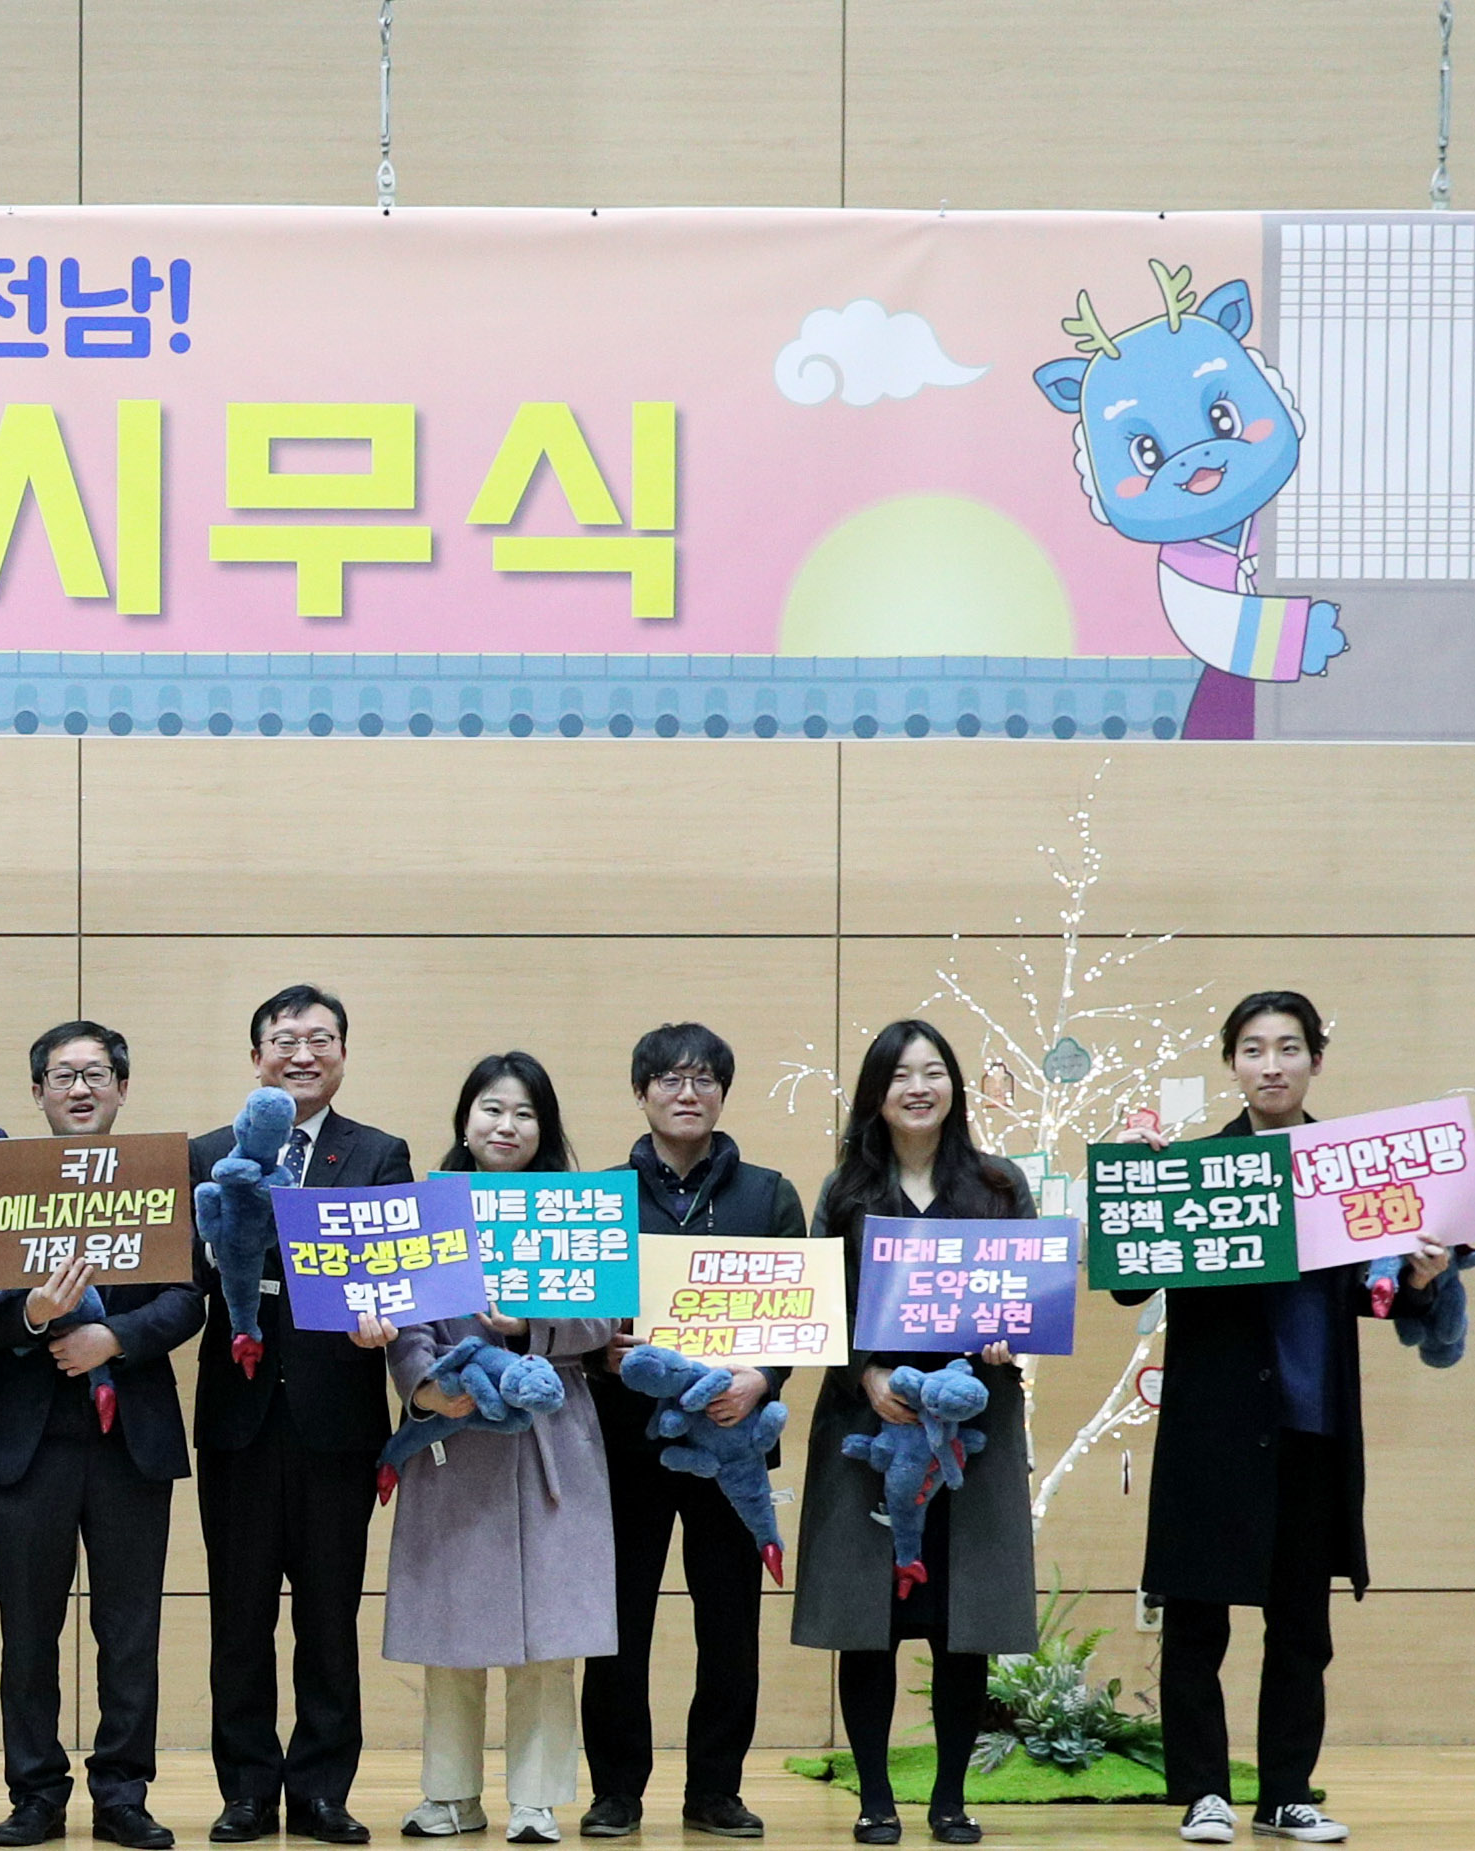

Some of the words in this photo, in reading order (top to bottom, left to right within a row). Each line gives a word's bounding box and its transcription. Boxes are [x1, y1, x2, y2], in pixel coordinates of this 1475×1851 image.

[61, 1147, 119, 1185] 국가
[1095, 1158, 1192, 1194] 브랜드
[1199, 1151, 1284, 1189] 파워,
[317, 1196, 422, 1236] 도민의
[534, 1188, 623, 1222] 청년농
[1099, 1200, 1165, 1235] 정책
[1173, 1192, 1282, 1232] 수요자
[1339, 1182, 1425, 1242] 강화
[83, 1233, 142, 1271] 육성
[512, 1227, 629, 1262] 살기좋은
[872, 1237, 963, 1264] 미래로
[973, 1236, 1069, 1262] 세계로
[1116, 1238, 1184, 1275] 맞춤
[1193, 1235, 1266, 1272] 광고
[538, 1267, 596, 1302] 조성
[689, 1251, 805, 1284] 대한민국
[907, 1268, 1028, 1299] 도약하는
[343, 1278, 417, 1316] 확보
[670, 1288, 814, 1322] 우주발사체
[899, 1302, 961, 1334] 전남
[971, 1300, 1033, 1334] 실현
[764, 1323, 829, 1354] 도약
